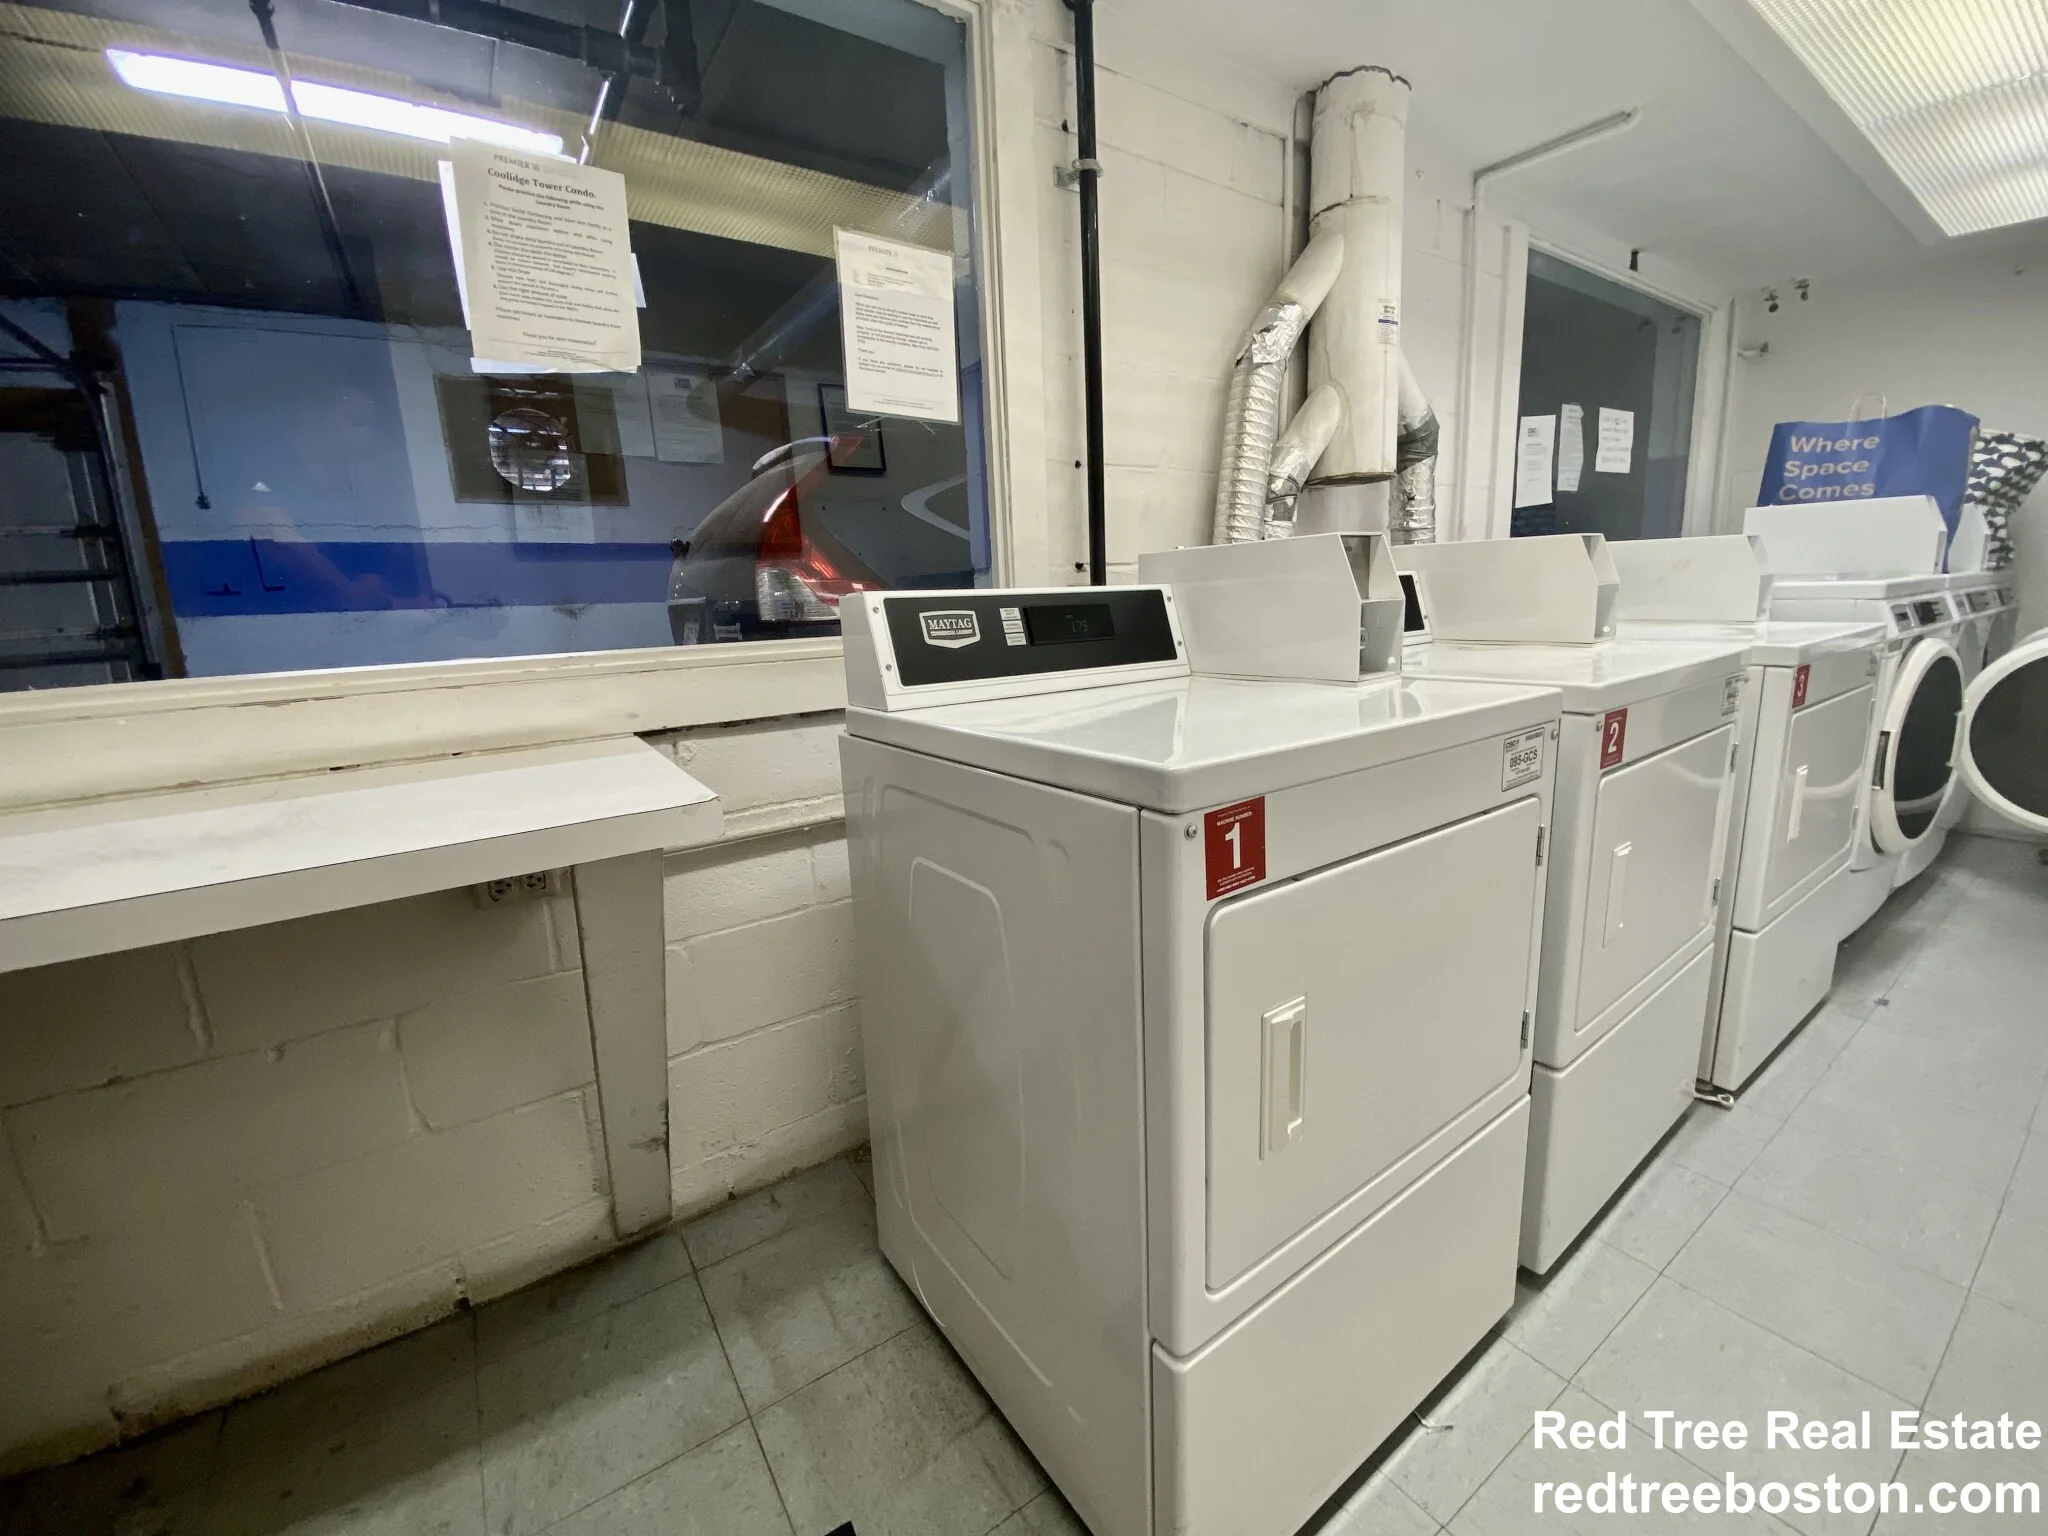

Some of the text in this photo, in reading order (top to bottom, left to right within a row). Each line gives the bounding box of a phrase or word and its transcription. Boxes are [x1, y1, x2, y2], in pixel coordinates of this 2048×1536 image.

[492, 153, 530, 169] PREMIER
[487, 167, 530, 186] Coolidge
[531, 178, 562, 192] Tower
[565, 184, 596, 198] Condo.
[1790, 435, 1881, 454] Where
[1784, 459, 1871, 481] Space
[1778, 481, 1876, 502] Comes
[927, 618, 972, 630] MAYTAG
[1797, 674, 1805, 697] 3
[1607, 721, 1619, 755] 2
[1509, 749, 1538, 768] 095-GCS
[1225, 822, 1241, 869] 1
